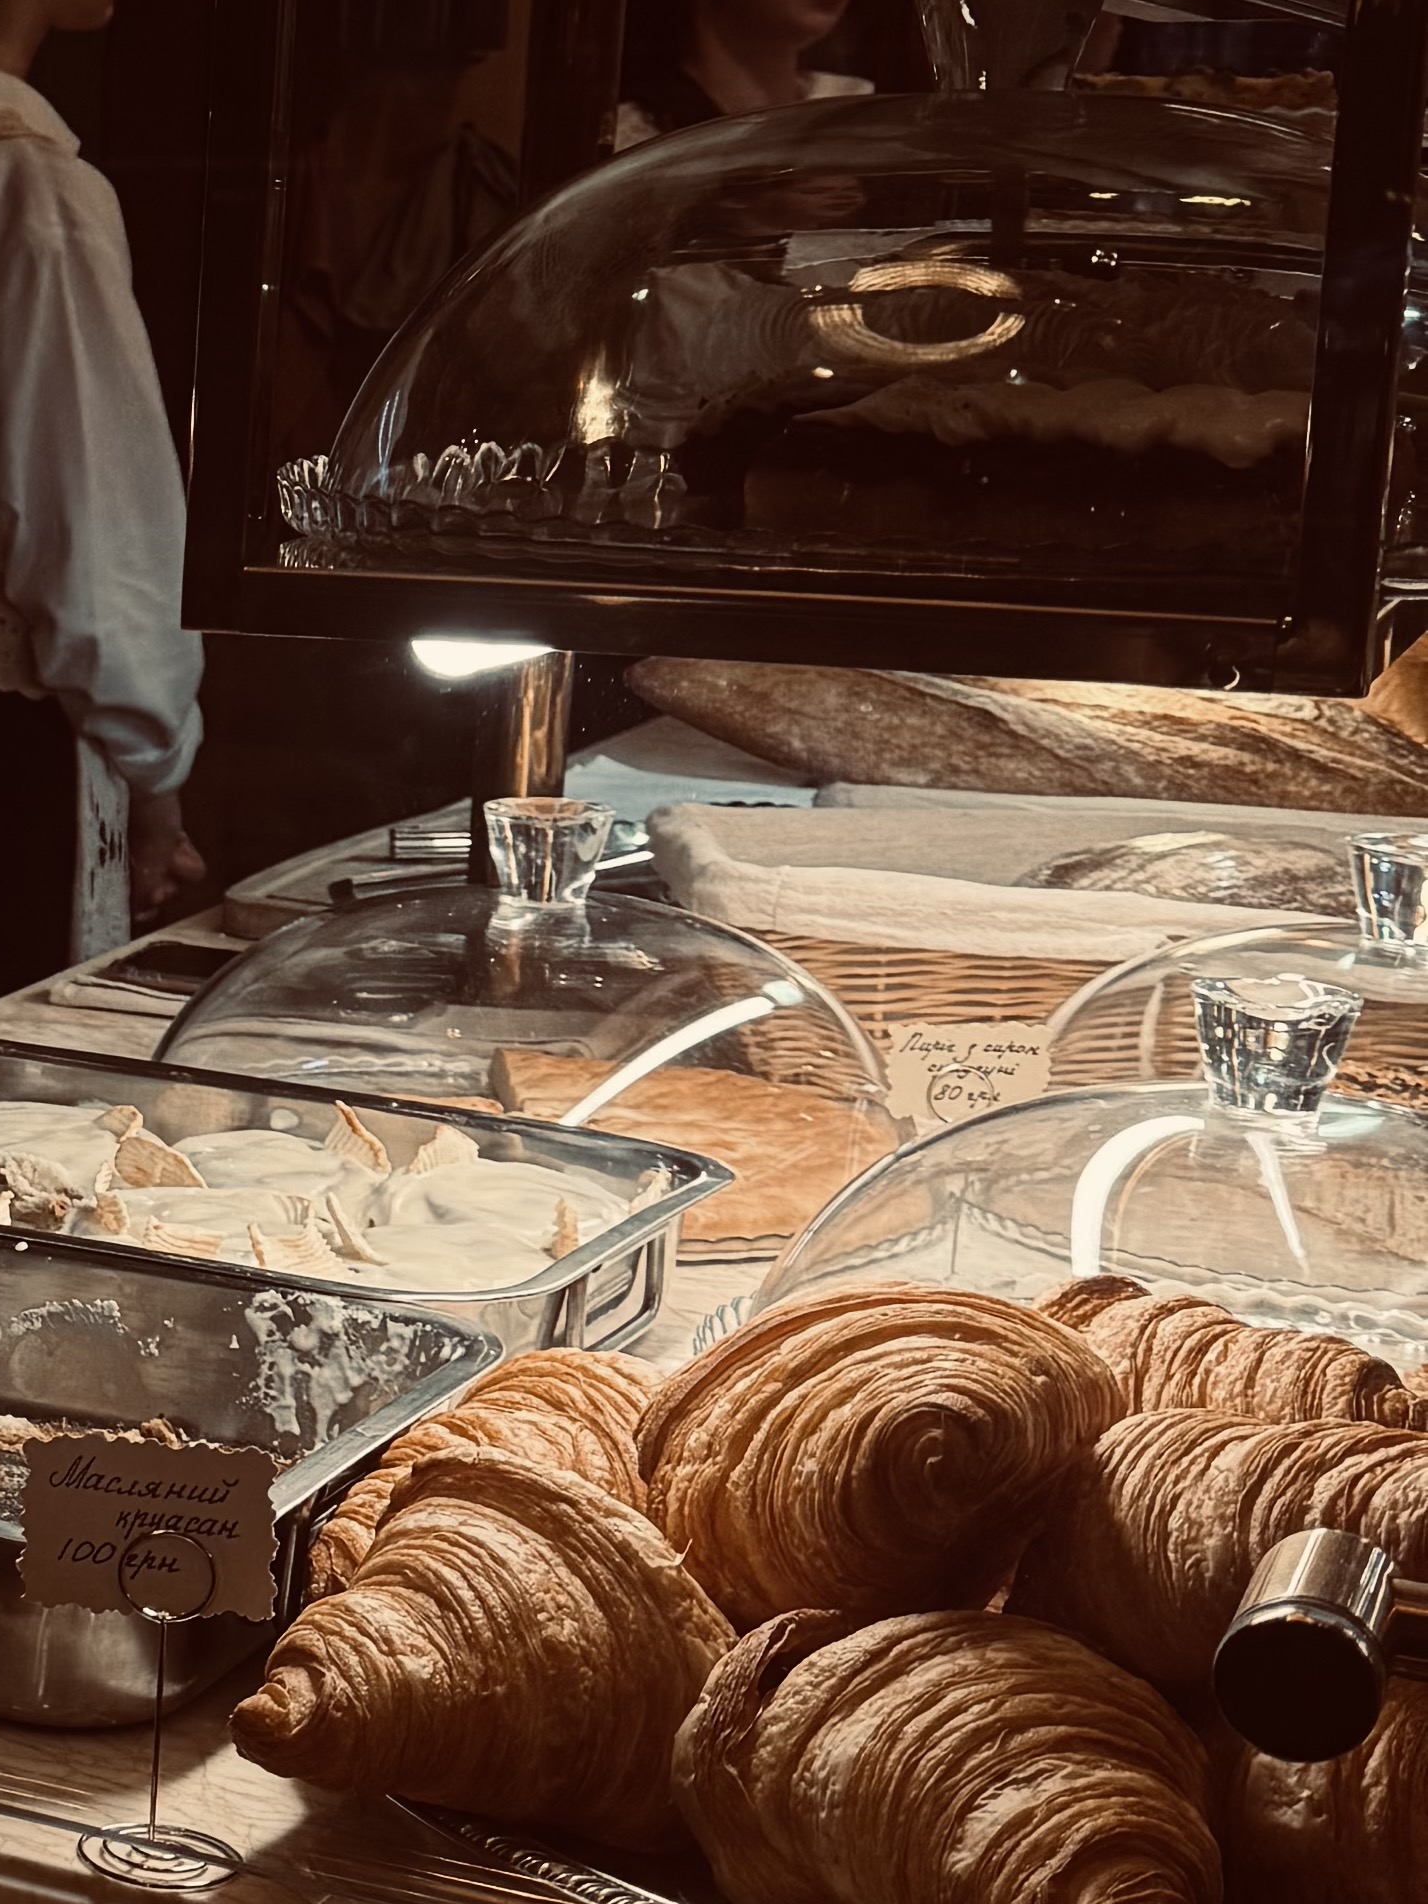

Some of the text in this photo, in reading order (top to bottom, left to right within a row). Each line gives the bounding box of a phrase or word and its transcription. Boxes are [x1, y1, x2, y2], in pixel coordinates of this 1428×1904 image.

[933, 1083, 964, 1102] 80
[49, 1454, 240, 1505] Масляний
[115, 1508, 241, 1540] круасан
[57, 1538, 181, 1580] 100 грн
